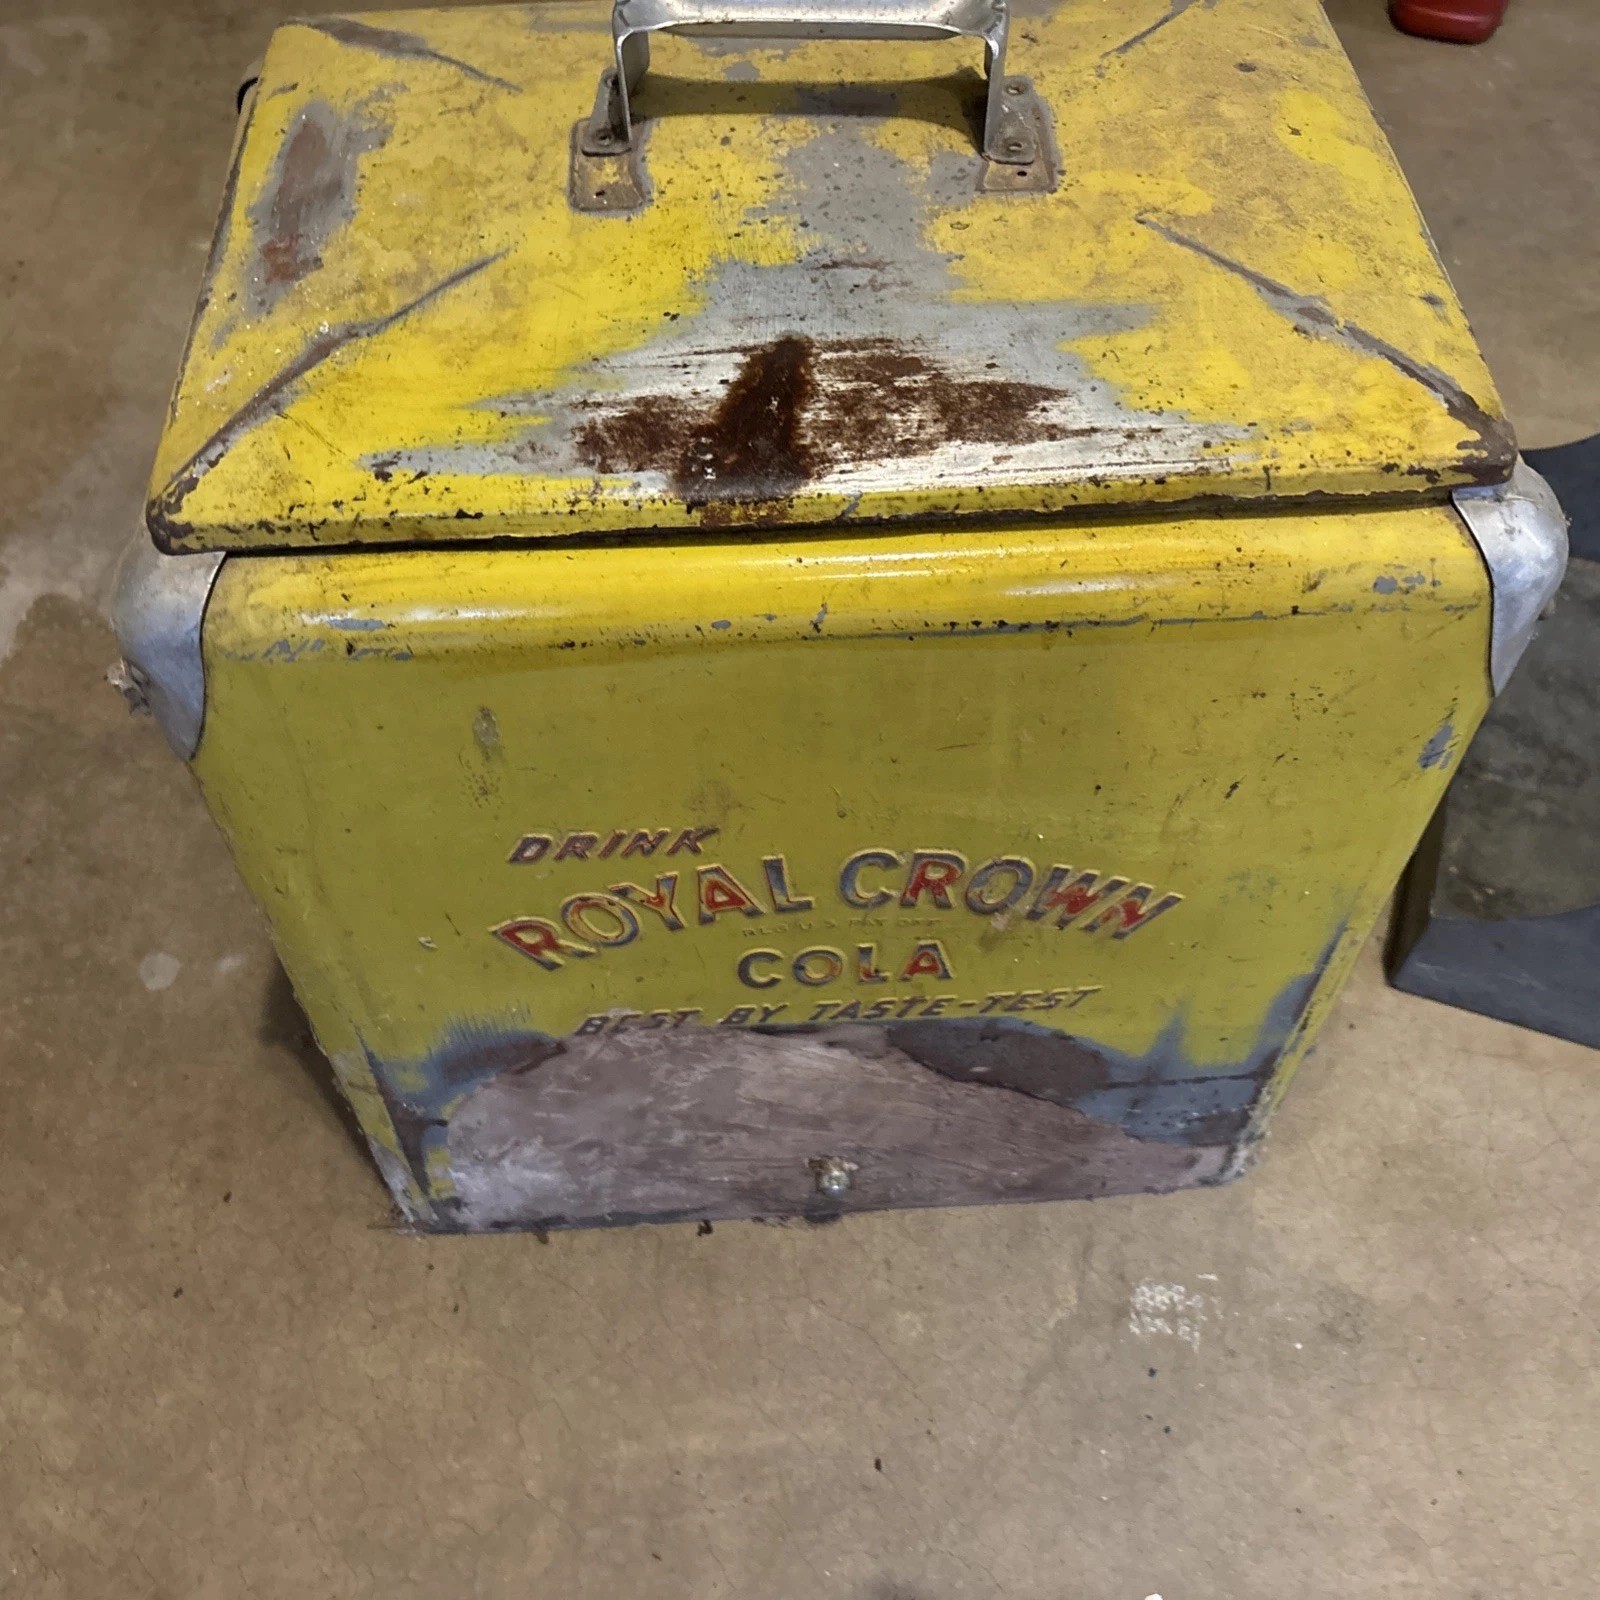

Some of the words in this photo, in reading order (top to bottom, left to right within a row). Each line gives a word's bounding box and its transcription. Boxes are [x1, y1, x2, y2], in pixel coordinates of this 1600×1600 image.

[508, 827, 720, 864] DRINK
[487, 854, 816, 973] ROYAL
[838, 847, 1185, 941] CROWN
[737, 939, 954, 989] COLA
[574, 1007, 703, 1037] BEST
[718, 1003, 789, 1026] BY
[808, 985, 1103, 1021] TASTE-TEST
